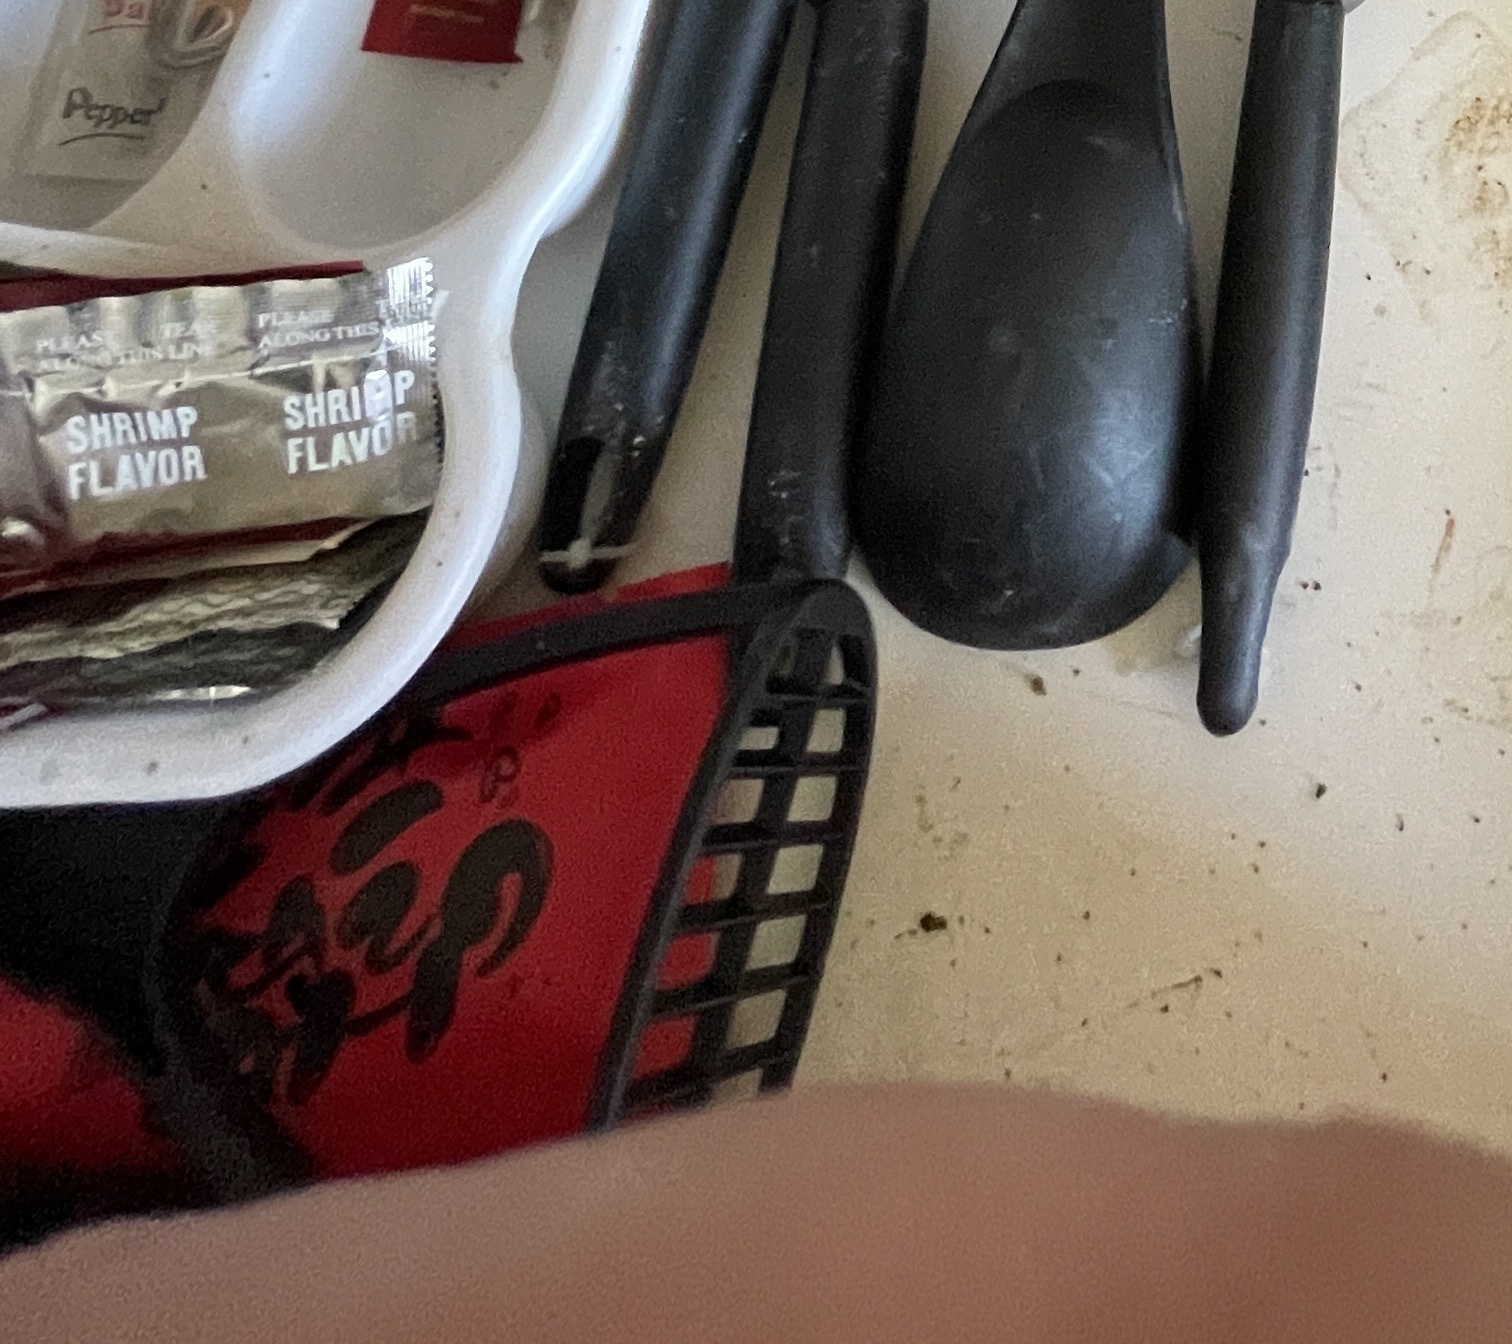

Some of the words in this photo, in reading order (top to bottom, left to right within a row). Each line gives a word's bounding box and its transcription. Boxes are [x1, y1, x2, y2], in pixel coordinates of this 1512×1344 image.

[63, 87, 168, 129] Pepper
[258, 329, 331, 350] ALONG
[66, 406, 198, 454] SHRIMP
[287, 411, 417, 475] FLAVOR
[69, 445, 208, 500] FLAVOR
